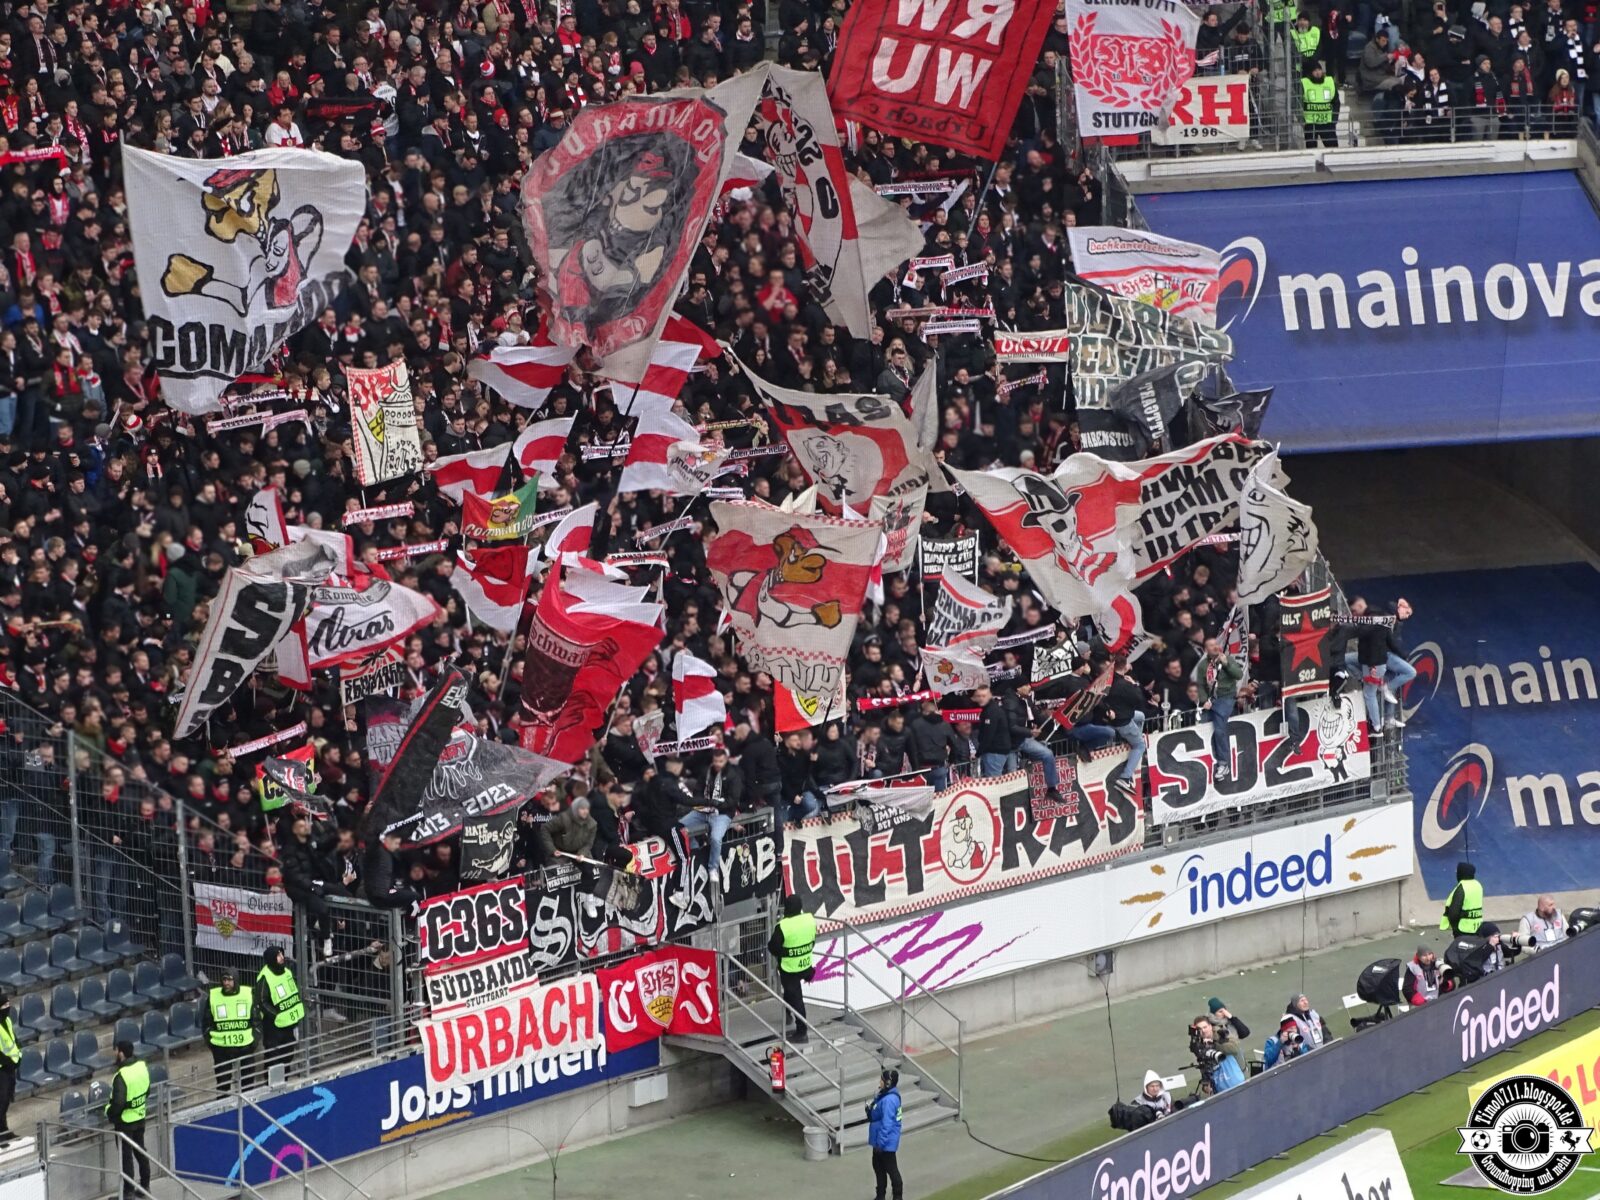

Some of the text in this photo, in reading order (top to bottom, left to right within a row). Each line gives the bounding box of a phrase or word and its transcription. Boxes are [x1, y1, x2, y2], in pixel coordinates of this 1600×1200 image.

[1092, 112, 1159, 128] STUTTGA
[1278, 246, 1600, 331] mainova
[1136, 468, 1229, 536] TURM
[1282, 606, 1331, 626] ULT RAS
[1453, 646, 1600, 708] main
[656, 739, 710, 753] COMMANDO
[462, 783, 517, 816] 2023
[874, 807, 905, 823] IMME
[464, 823, 488, 837] HATE
[478, 830, 499, 845] COPS
[1188, 833, 1333, 915] indeed
[425, 884, 525, 962] C36S
[430, 953, 537, 1005] SÜDBANDE
[465, 987, 509, 1009] STUTTGART
[216, 1021, 249, 1031] STEWARD
[425, 982, 595, 1082] URBACH
[1461, 964, 1561, 1062] indeed
[1100, 1122, 1212, 1200] indeed
